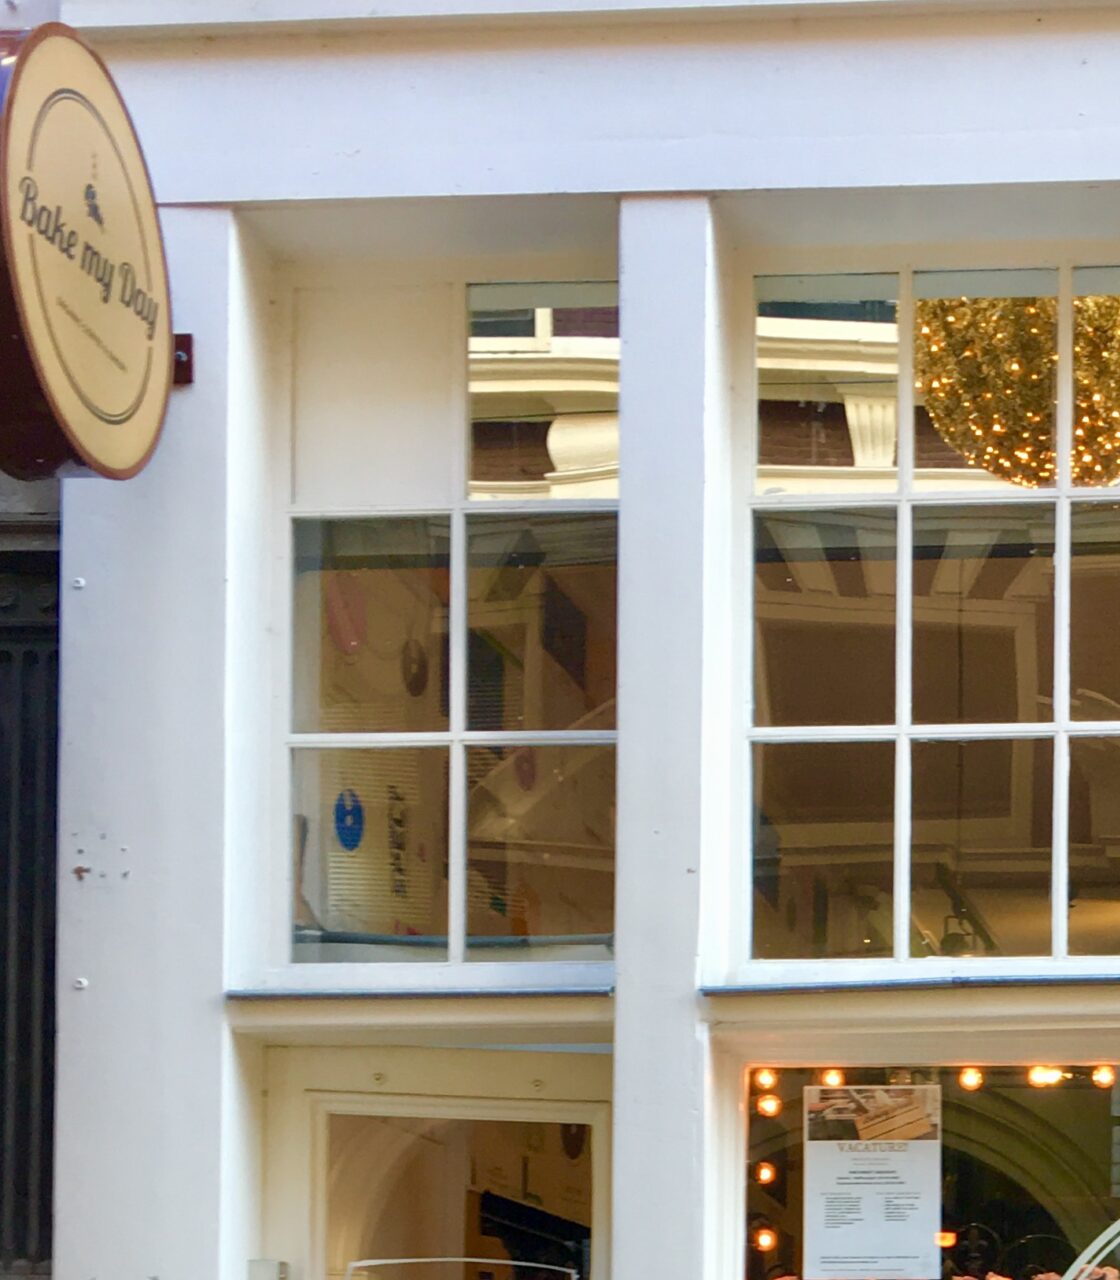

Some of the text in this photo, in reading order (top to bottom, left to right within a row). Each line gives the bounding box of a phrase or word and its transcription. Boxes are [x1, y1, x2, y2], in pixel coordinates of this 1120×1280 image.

[19, 176, 78, 261] Bake
[80, 236, 115, 304] my
[117, 261, 160, 341] Day
